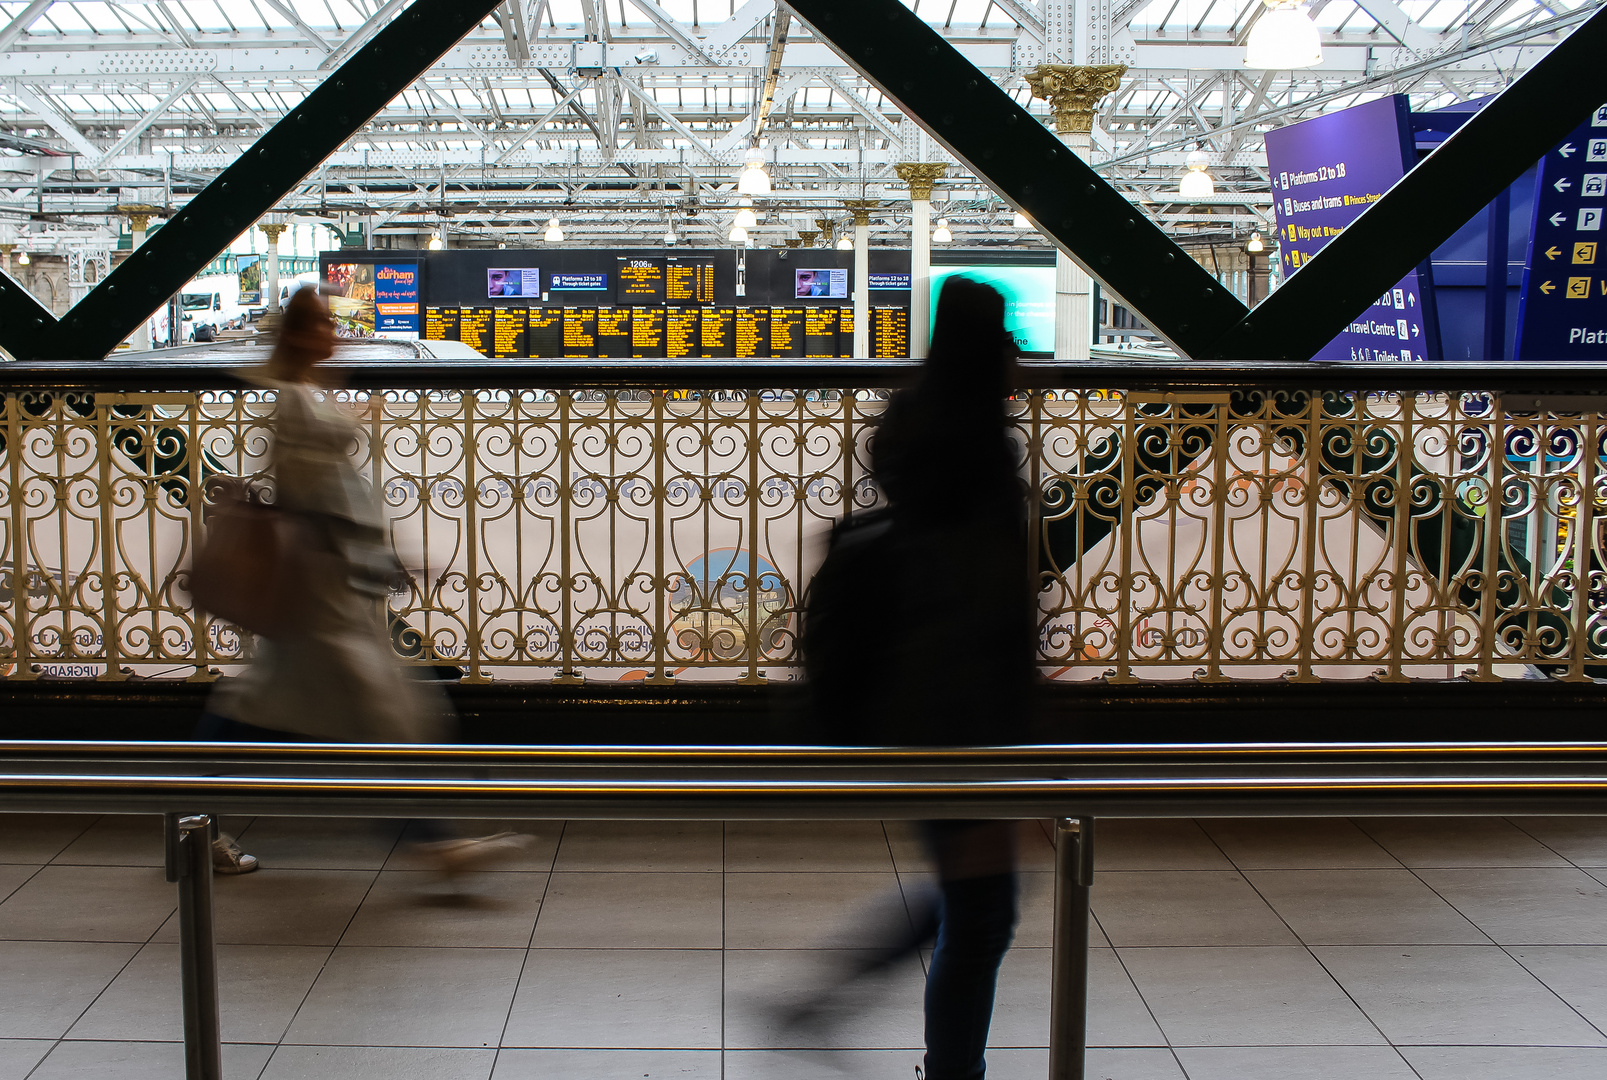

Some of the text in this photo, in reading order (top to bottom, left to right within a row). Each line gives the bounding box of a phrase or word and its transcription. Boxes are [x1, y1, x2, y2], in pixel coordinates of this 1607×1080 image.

[1289, 162, 1346, 186] Platforms 12 to 18
[1293, 196, 1343, 213] Buses and trams
[1350, 196, 1366, 205] Princes
[1297, 225, 1322, 241] Way out
[630, 260, 647, 268] 1206
[377, 270, 414, 279] durham
[1381, 291, 1391, 306] 20
[1350, 320, 1370, 334] Travel
[1370, 320, 1396, 336] Centre
[1373, 349, 1398, 361] Toilets
